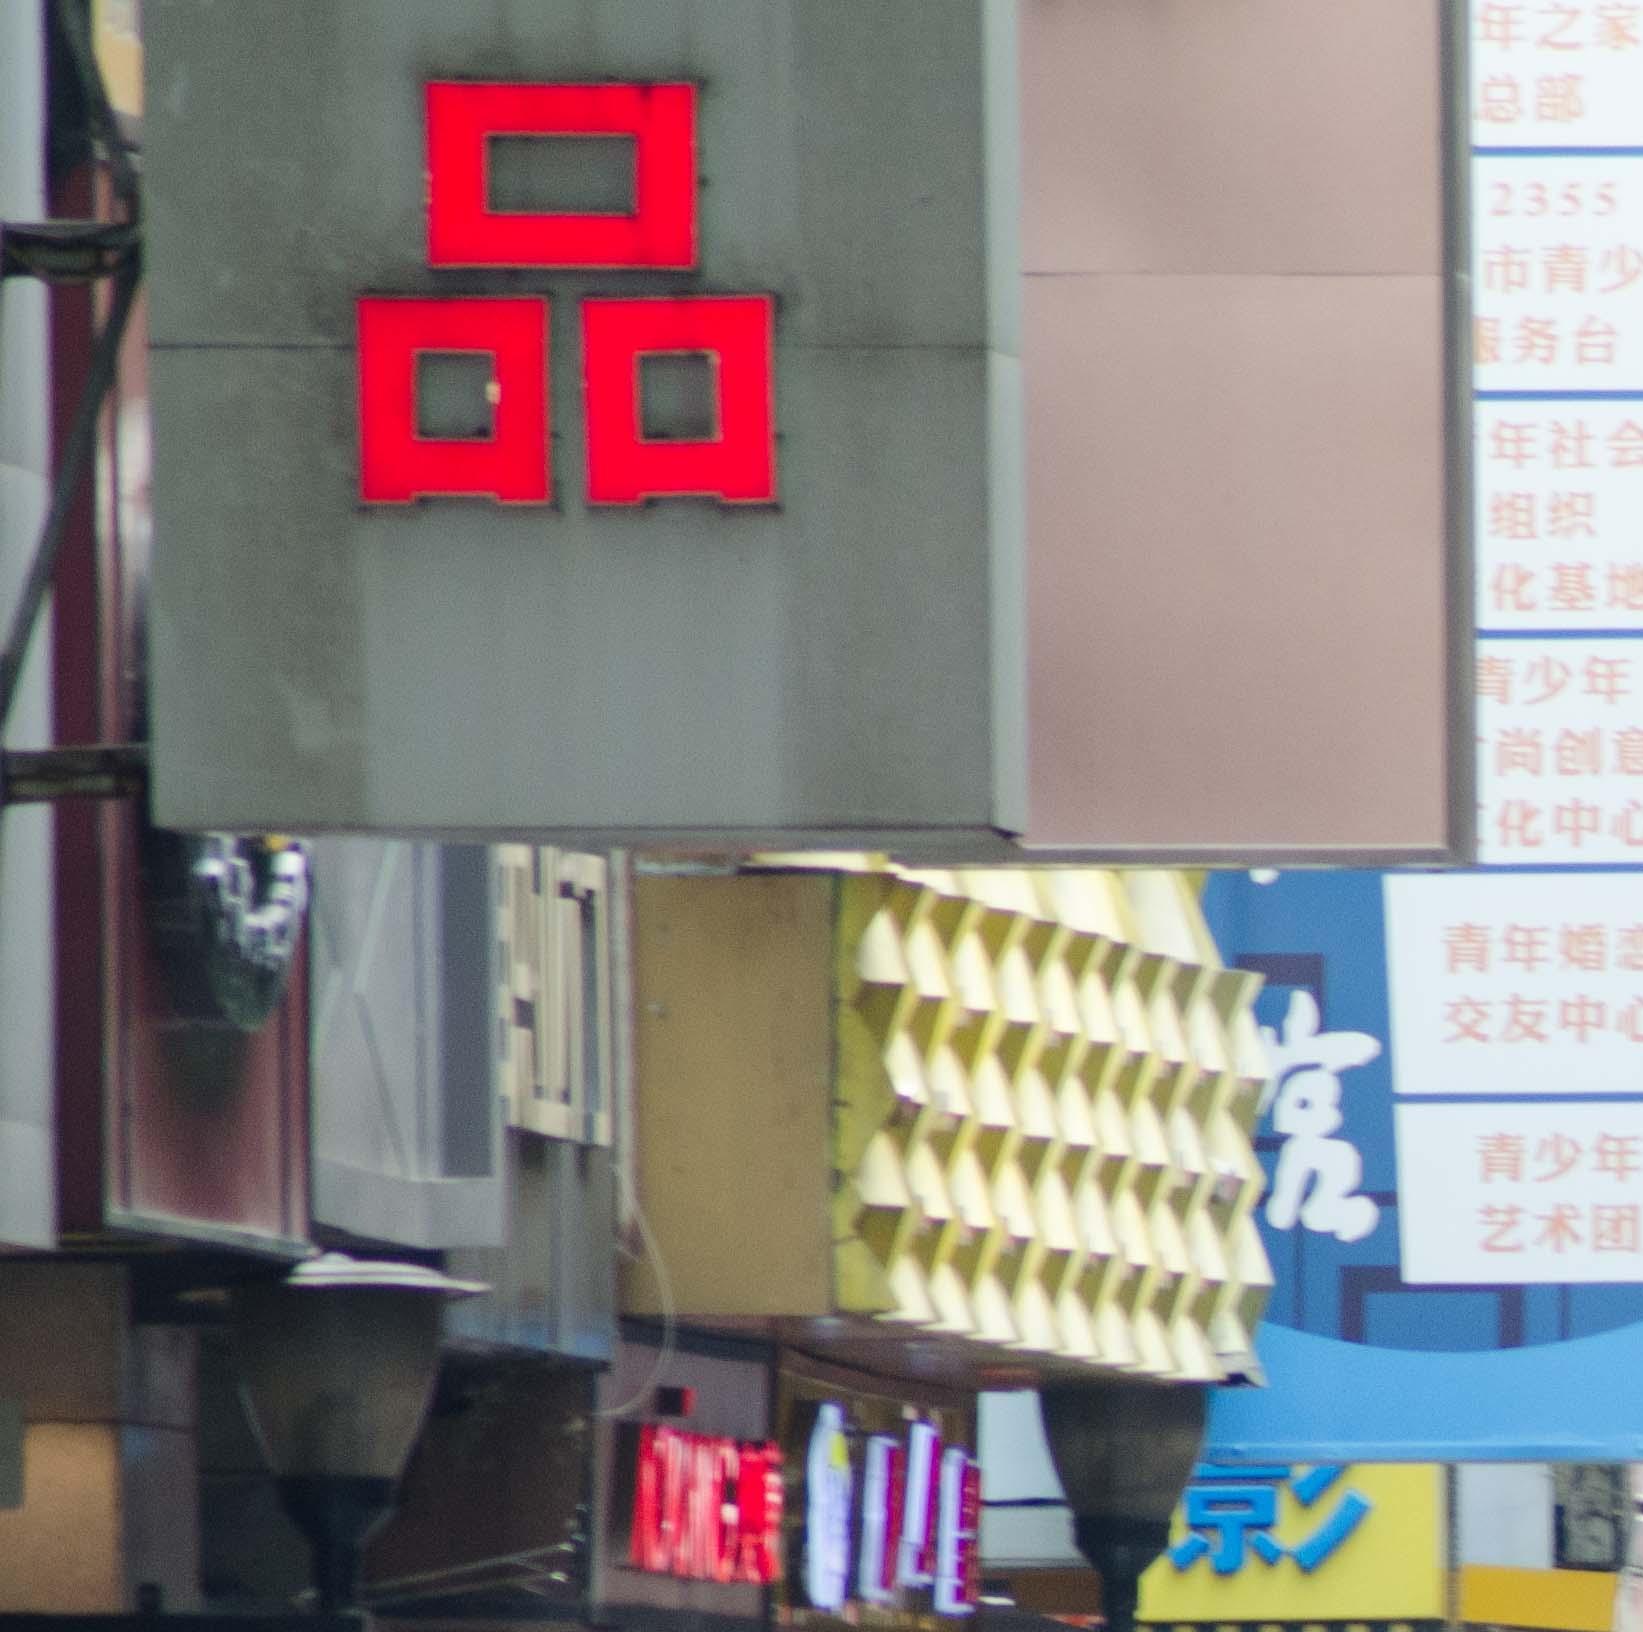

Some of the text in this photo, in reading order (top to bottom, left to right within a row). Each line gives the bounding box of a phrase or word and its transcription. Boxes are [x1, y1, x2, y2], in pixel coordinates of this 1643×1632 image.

[1475, 3, 1642, 51] 年之家
[1478, 74, 1584, 123] 总部
[1487, 182, 1618, 217] 2355
[1489, 491, 1596, 539] 组织
[1475, 655, 1632, 703] 青少年
[1476, 1132, 1643, 1184] 青少年
[1476, 1204, 1643, 1254] 艺术团
